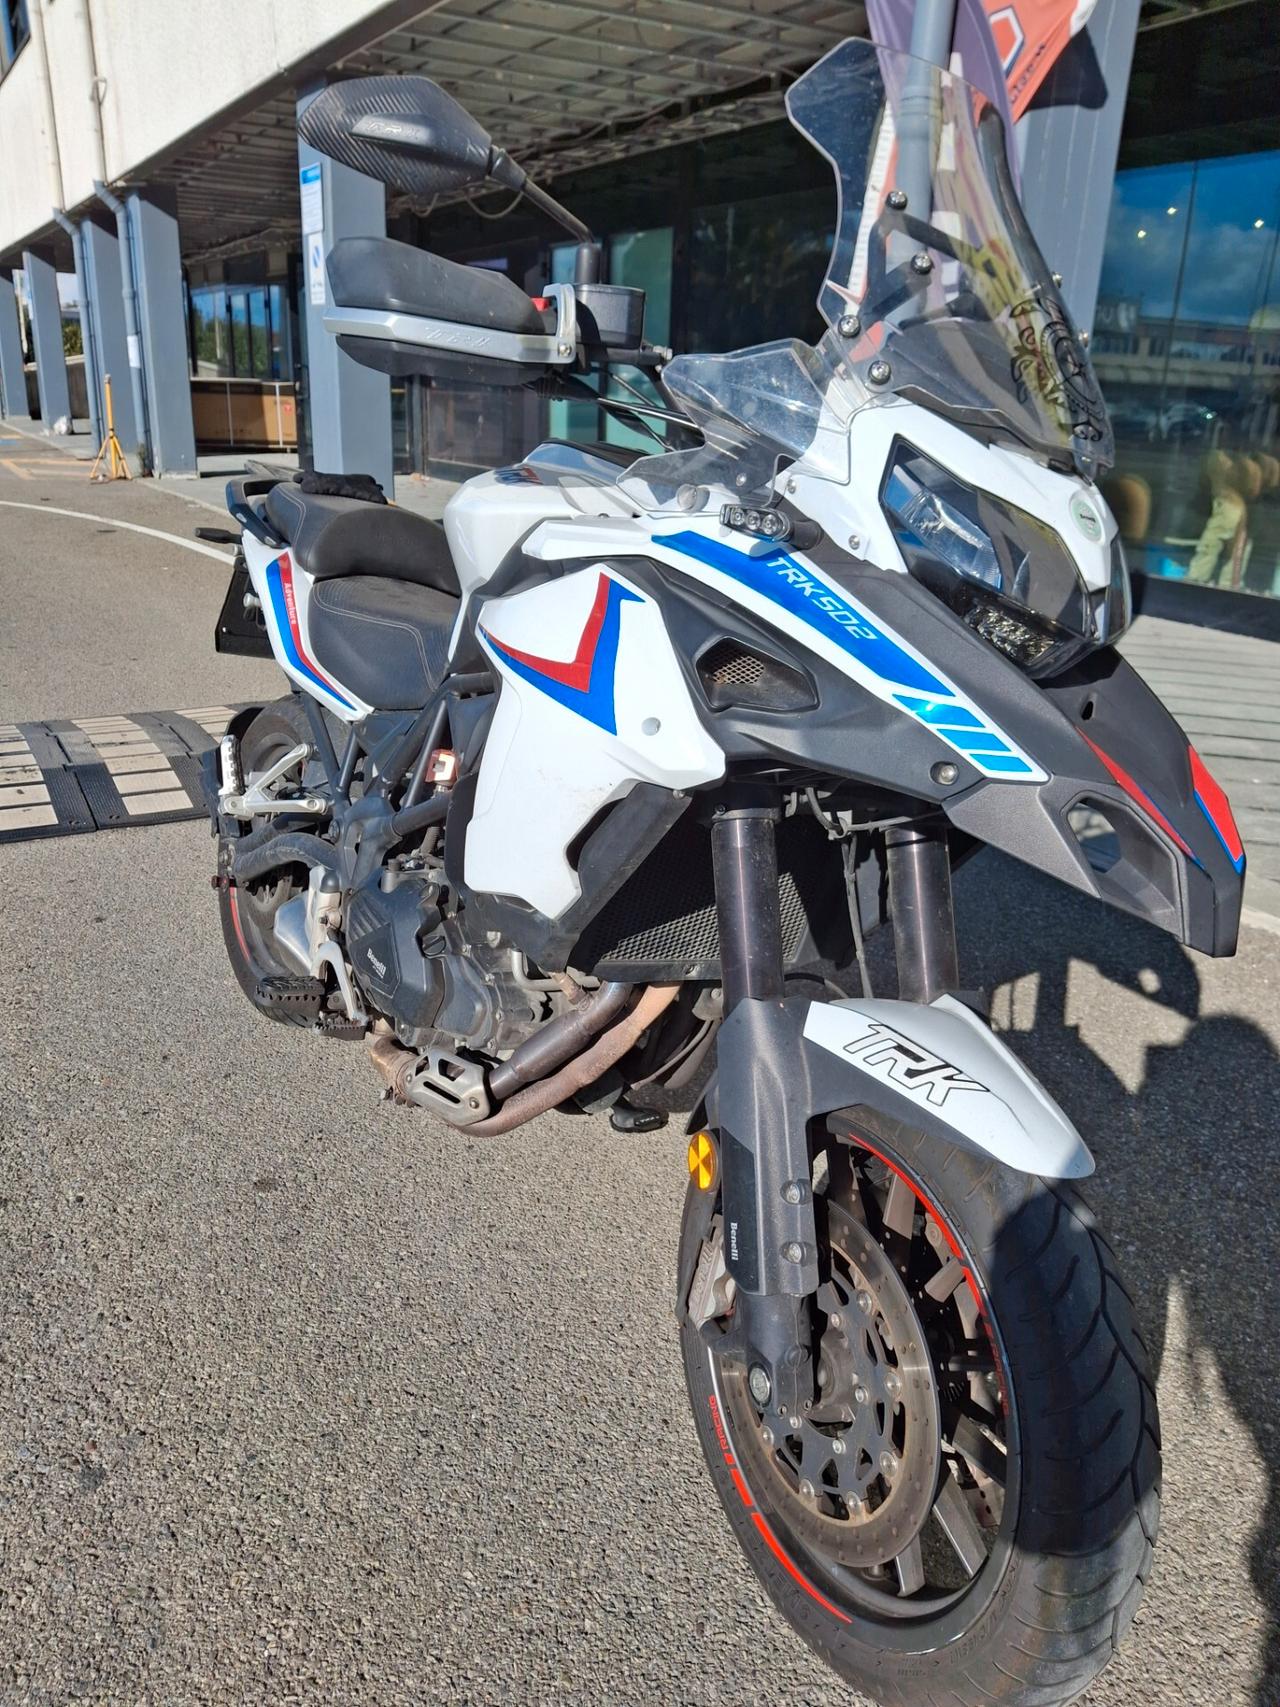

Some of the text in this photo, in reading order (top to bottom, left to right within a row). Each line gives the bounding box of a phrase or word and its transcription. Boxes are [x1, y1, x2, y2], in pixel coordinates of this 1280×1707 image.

[284, 582, 297, 625] Adventure
[366, 947, 387, 977] Benelli
[843, 1023, 991, 1107] TRK
[730, 1222, 739, 1261] Benelli
[708, 1394, 729, 1450] RACING
